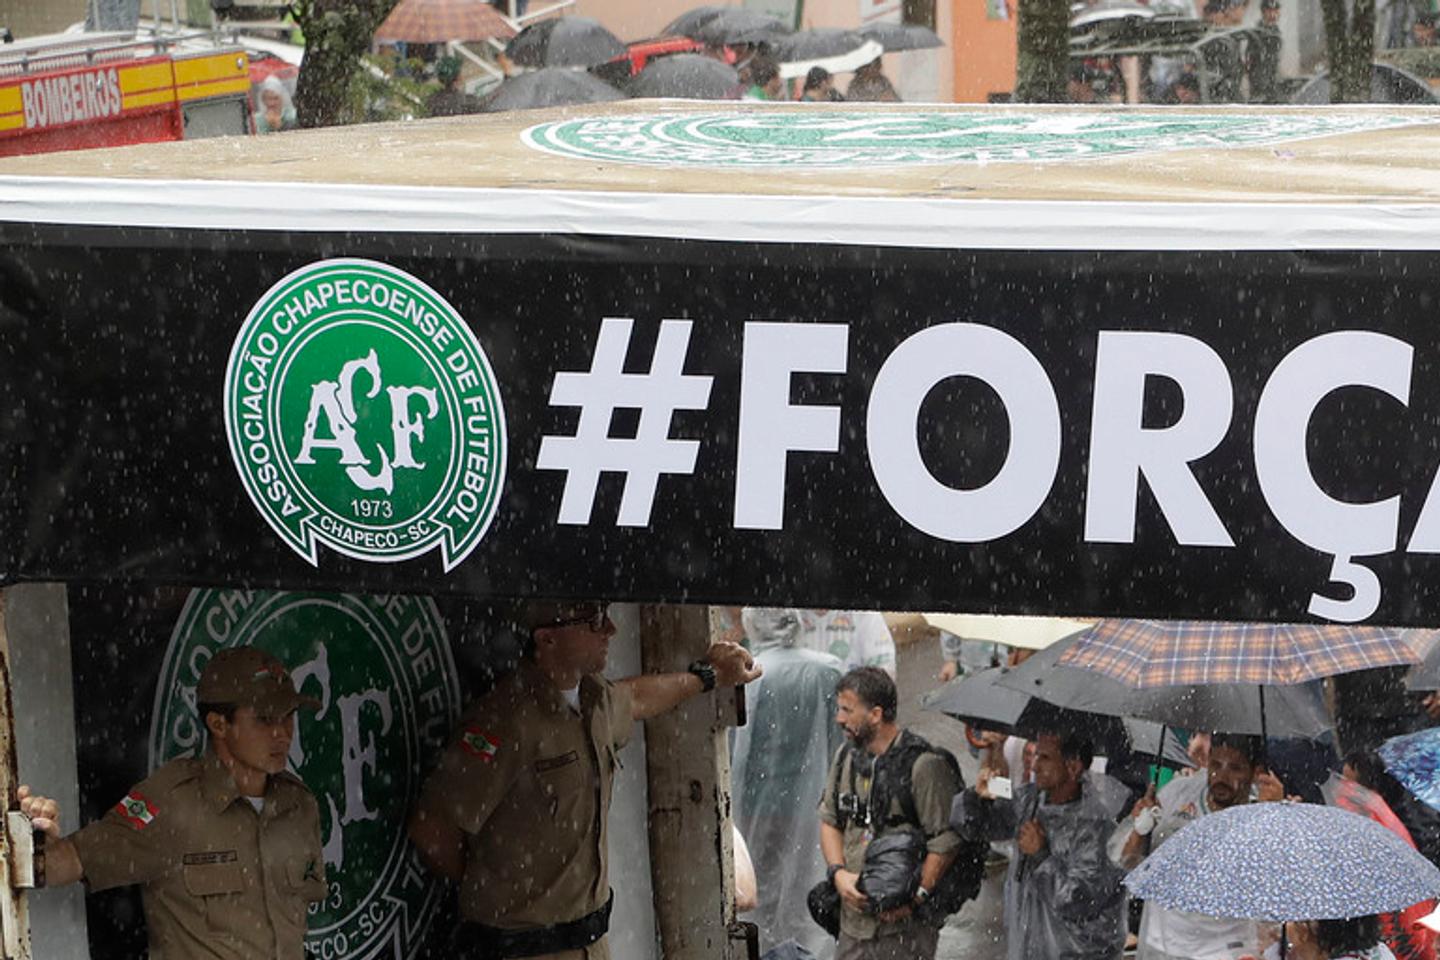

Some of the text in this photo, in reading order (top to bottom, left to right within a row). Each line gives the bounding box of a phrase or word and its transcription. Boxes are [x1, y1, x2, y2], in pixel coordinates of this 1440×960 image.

[21, 68, 121, 128] BOMBEIROS
[242, 279, 489, 523] ASSOCIAÇÃO CHAPECOENSE DE FUTEBOL
[351, 499, 393, 519] 1973
